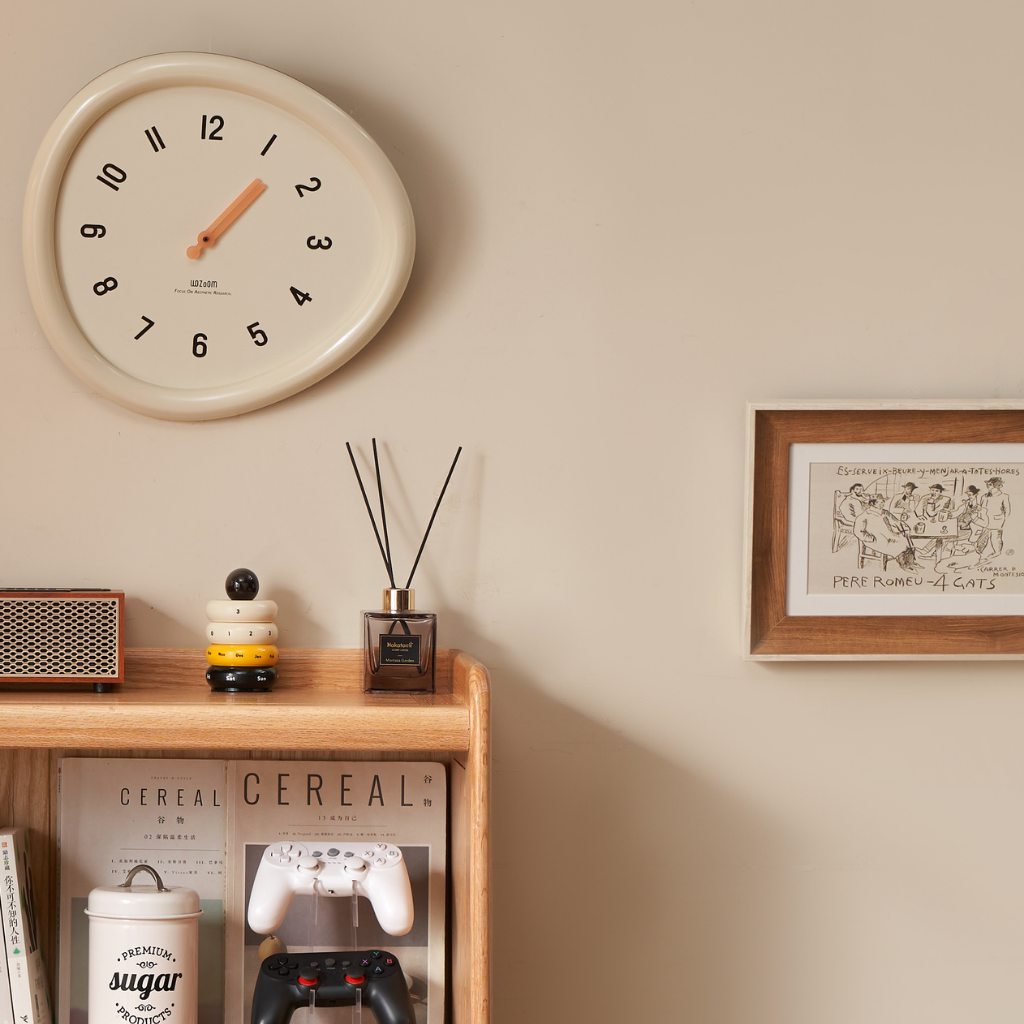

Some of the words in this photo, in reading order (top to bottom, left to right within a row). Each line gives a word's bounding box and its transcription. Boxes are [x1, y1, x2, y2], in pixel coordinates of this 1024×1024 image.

[201, 115, 225, 140] 12
[261, 134, 277, 156] 1
[96, 163, 127, 191] 10
[295, 177, 322, 198] 2
[80, 223, 106, 238] 9
[306, 235, 332, 250] 3
[93, 277, 118, 296] 8
[289, 286, 312, 306] 4
[134, 316, 155, 340] 7
[247, 322, 268, 346] 5
[192, 333, 208, 358] 6
[833, 575, 868, 589] PERE
[873, 577, 923, 587] ROMEU
[952, 577, 997, 590] GATS
[120, 787, 221, 807] CEREAL
[243, 772, 414, 807] CEREAL
[423, 774, 433, 808] 谷物
[158, 815, 185, 825] 谷物
[5, 875, 22, 946] 你不可不知的人性
[121, 945, 173, 961] PREMIUM
[109, 972, 183, 1000] sugar
